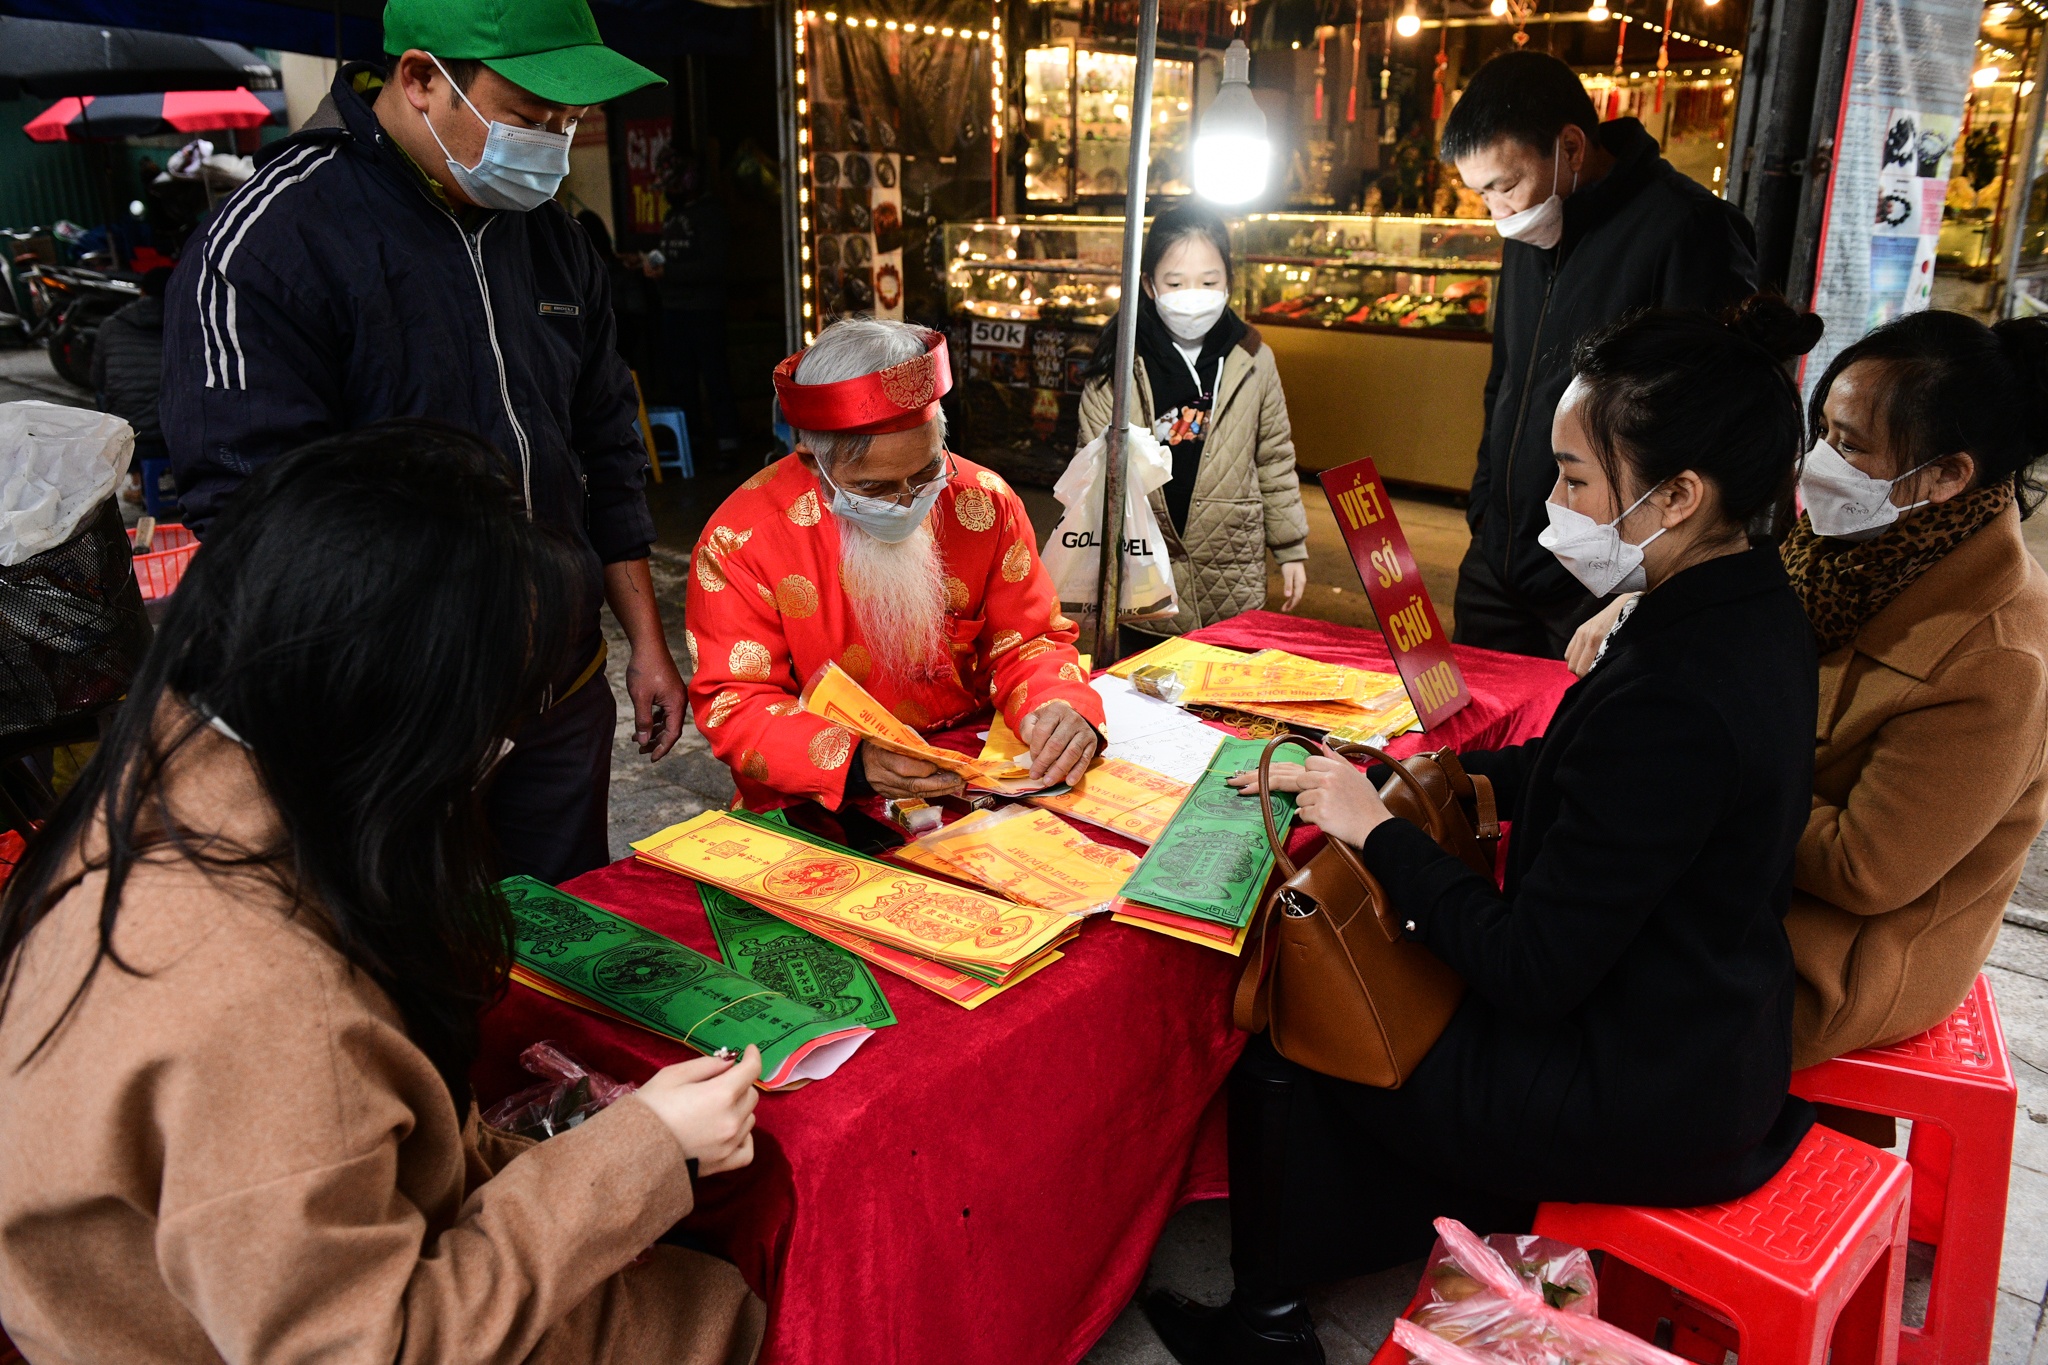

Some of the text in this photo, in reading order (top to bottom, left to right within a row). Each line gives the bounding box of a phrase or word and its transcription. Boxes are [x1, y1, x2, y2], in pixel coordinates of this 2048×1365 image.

[975, 322, 1022, 344] 50k
[1337, 473, 1386, 531] VIẾT
[1370, 537, 1403, 589] SỚ
[1389, 594, 1433, 653] CHỮ
[1413, 660, 1459, 715] NHO
